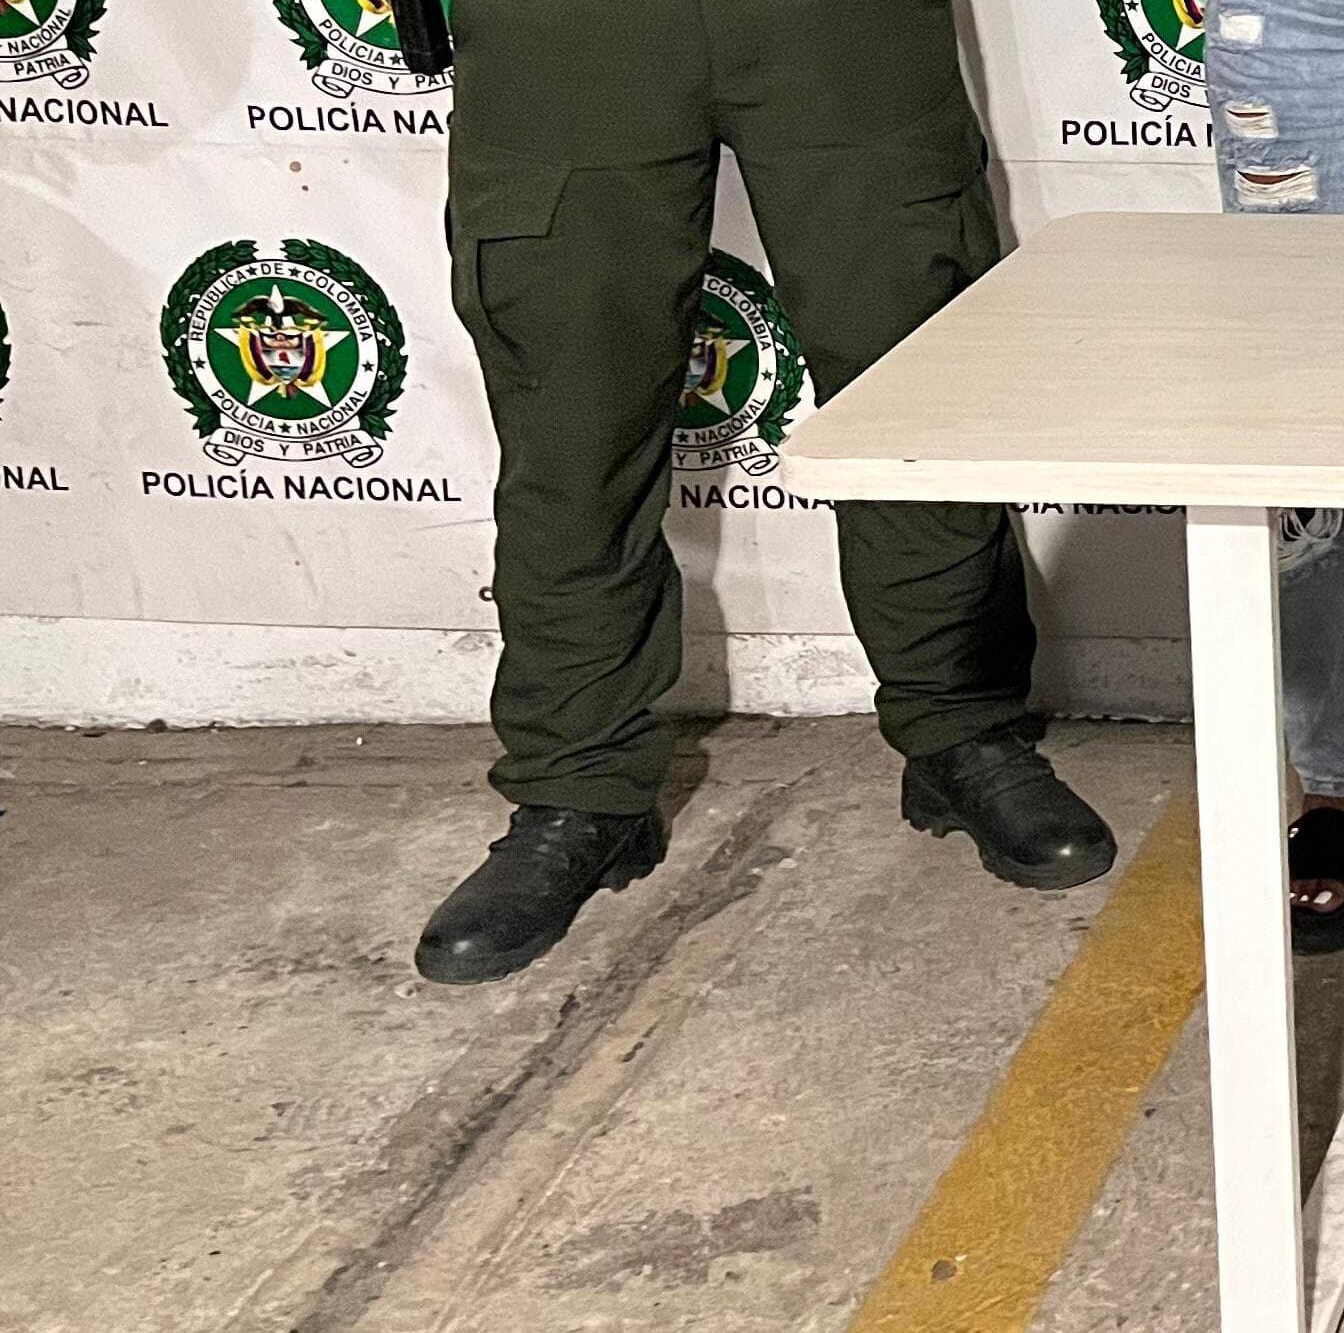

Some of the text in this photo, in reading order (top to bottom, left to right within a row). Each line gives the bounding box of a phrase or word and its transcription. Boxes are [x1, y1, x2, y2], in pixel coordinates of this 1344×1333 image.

[0, 97, 168, 126] NACIONAL
[248, 102, 386, 133] POLICÍA
[1062, 115, 1196, 147] POLICÍA
[190, 262, 372, 342] REPUBLICA DE COLOMBIA
[211, 388, 367, 435] POLICIA NACIONAL
[224, 431, 362, 456] DIOS Y PATRIA
[142, 469, 461, 501] POLICÍA NACIONAL
